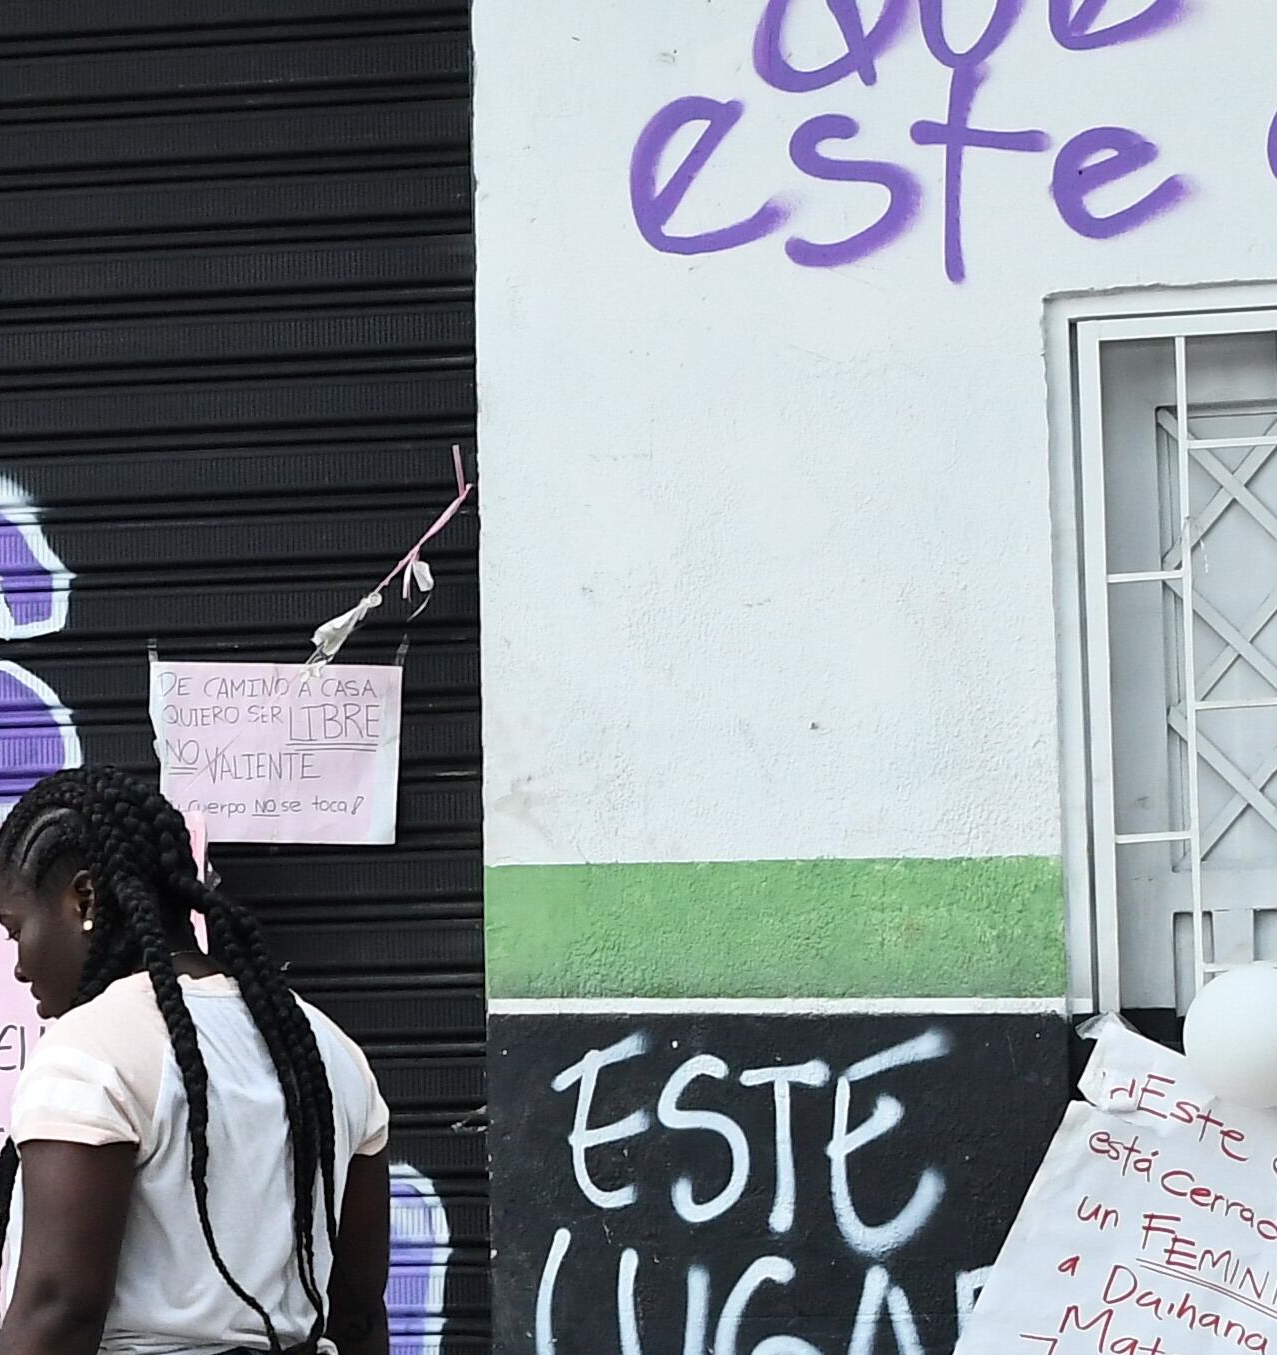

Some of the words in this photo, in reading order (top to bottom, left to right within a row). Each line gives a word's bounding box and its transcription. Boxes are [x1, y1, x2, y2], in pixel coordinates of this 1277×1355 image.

[630, 64, 1189, 284] este
[158, 672, 192, 697] DE
[204, 676, 289, 699] CAMINO
[298, 681, 312, 698] A
[321, 678, 378, 698] CASA
[163, 704, 240, 727] QUIERO
[289, 703, 380, 742] LIBRE
[165, 739, 198, 766] NO
[204, 746, 322, 784] VALIENTE
[255, 799, 277, 814] NO
[282, 801, 302, 812] se
[552, 1028, 955, 1255] ESTE
[1077, 1195, 1120, 1231] un
[1057, 1255, 1081, 1277] a
